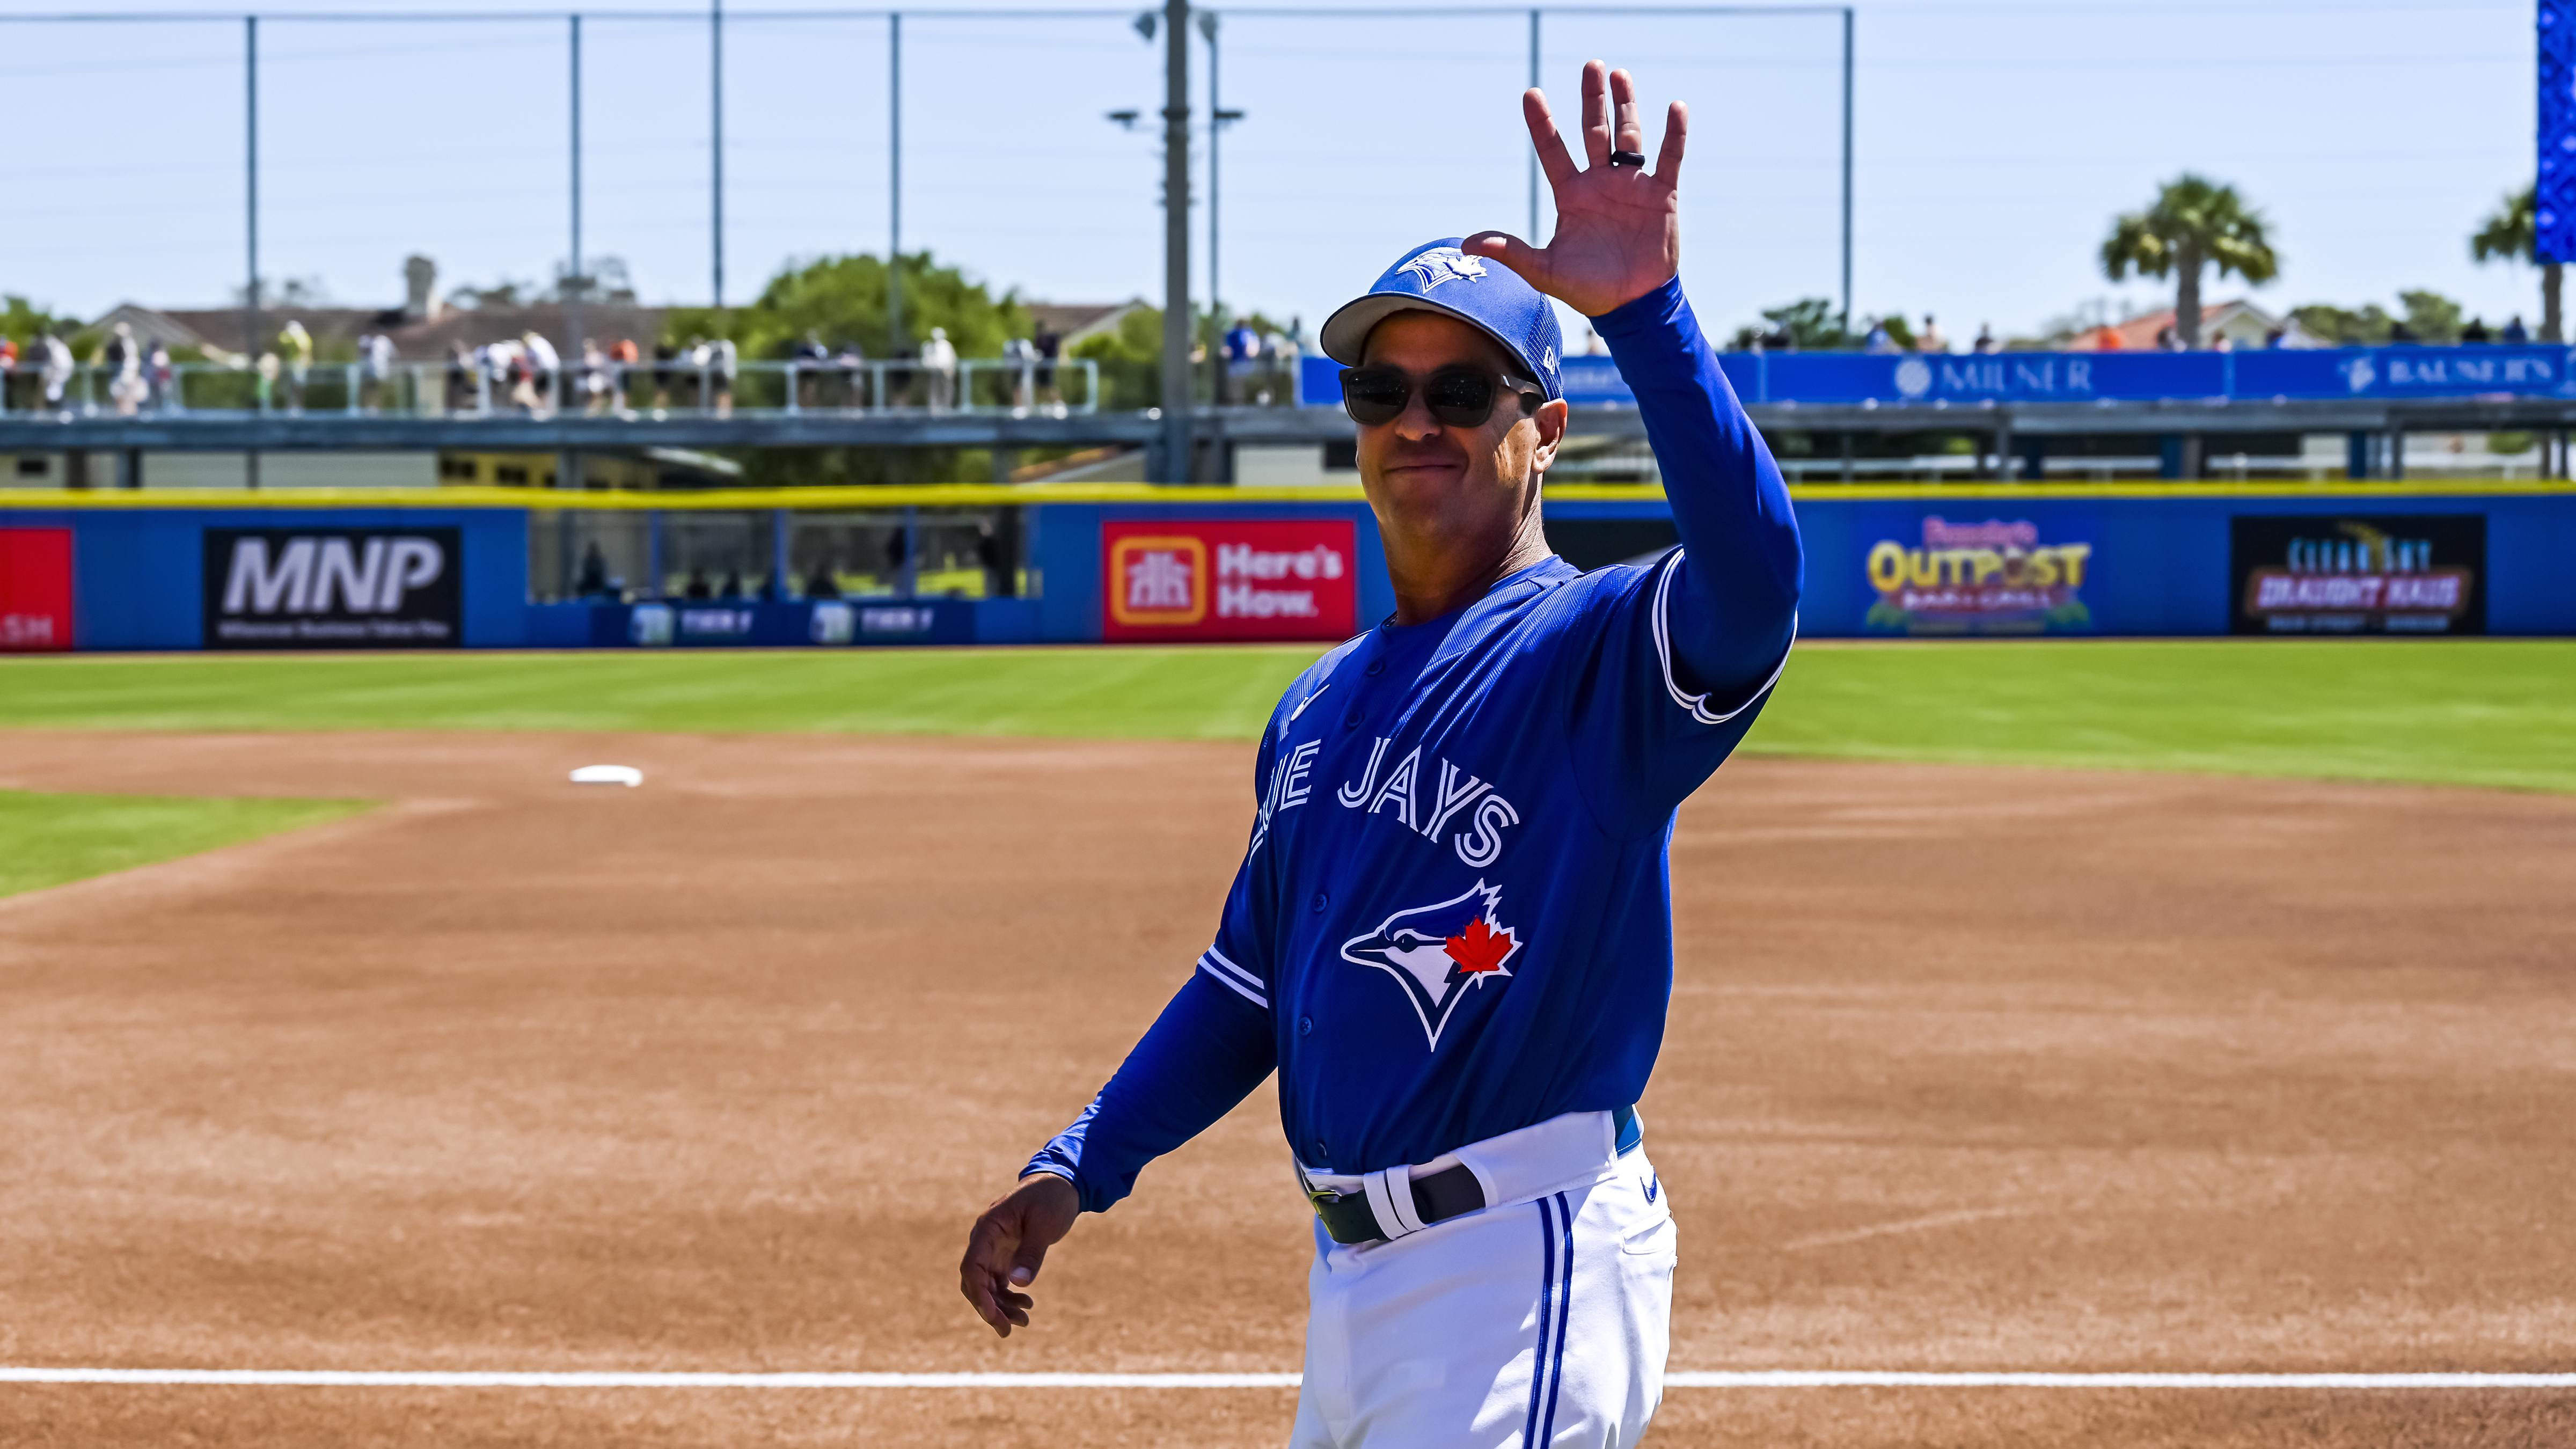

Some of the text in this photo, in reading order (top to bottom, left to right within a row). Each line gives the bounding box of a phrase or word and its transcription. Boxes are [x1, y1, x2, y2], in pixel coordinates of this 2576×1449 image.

[1940, 358, 2091, 393] MILNER
[222, 536, 444, 614] MNP
[1216, 543, 1343, 579] Here's
[1867, 540, 2091, 592] OUTPOST
[1216, 585, 1319, 617] How.
[1337, 737, 1519, 867] JAYS
